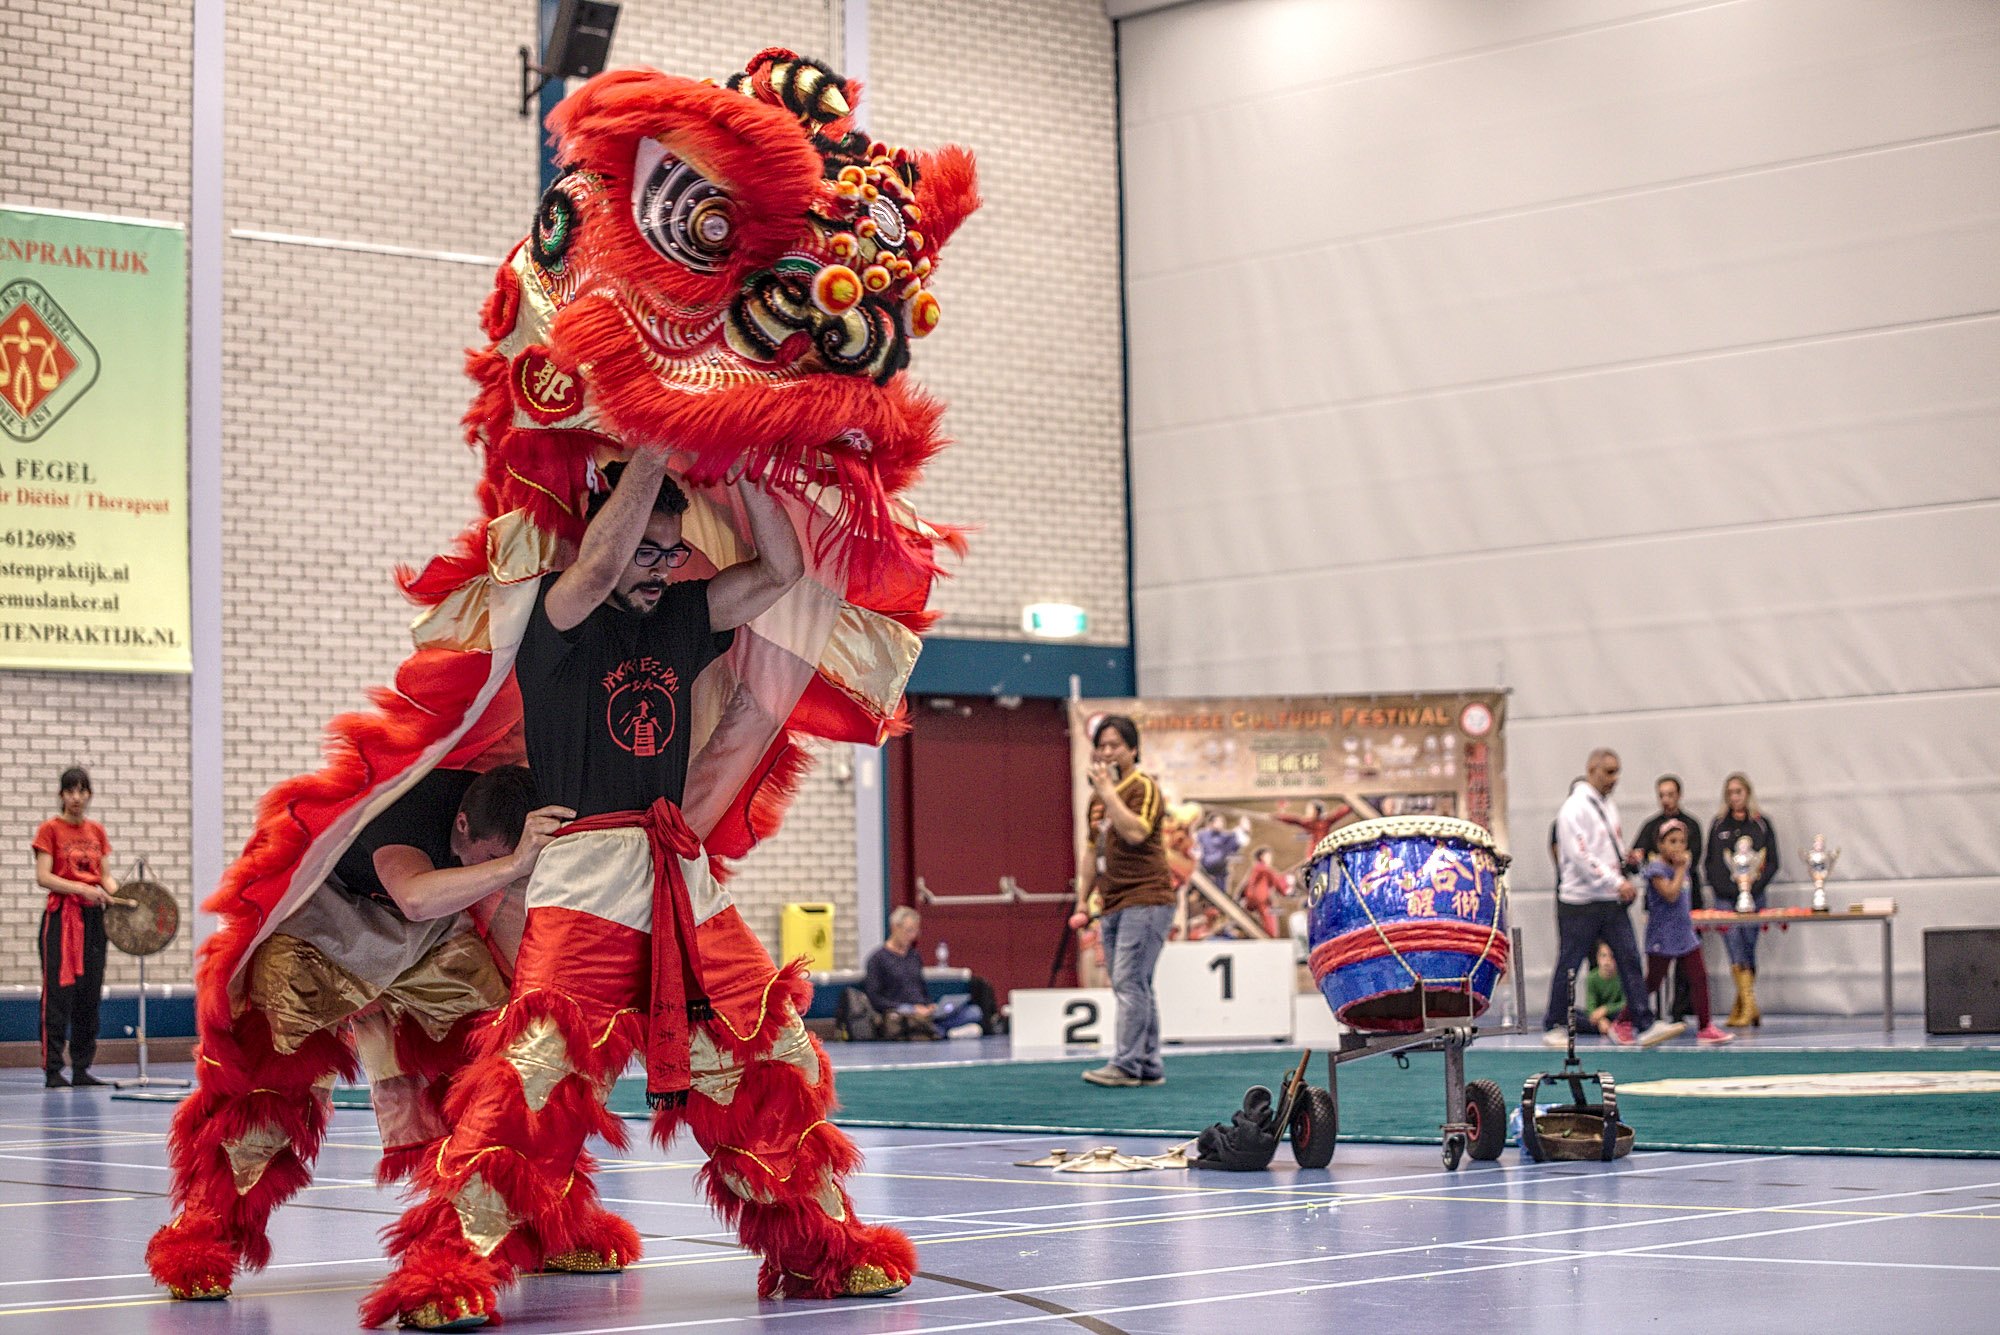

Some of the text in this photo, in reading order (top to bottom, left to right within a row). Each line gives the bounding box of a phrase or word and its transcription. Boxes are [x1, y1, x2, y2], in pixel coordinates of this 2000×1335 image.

[16, 458, 96, 484] FEGEL
[86, 492, 169, 516] Therapeut
[1231, 709, 1334, 731] CULTUUR
[1342, 706, 1450, 728] FESTIVAL
[1208, 954, 1233, 1000] 1
[1064, 1000, 1099, 1044] 2
